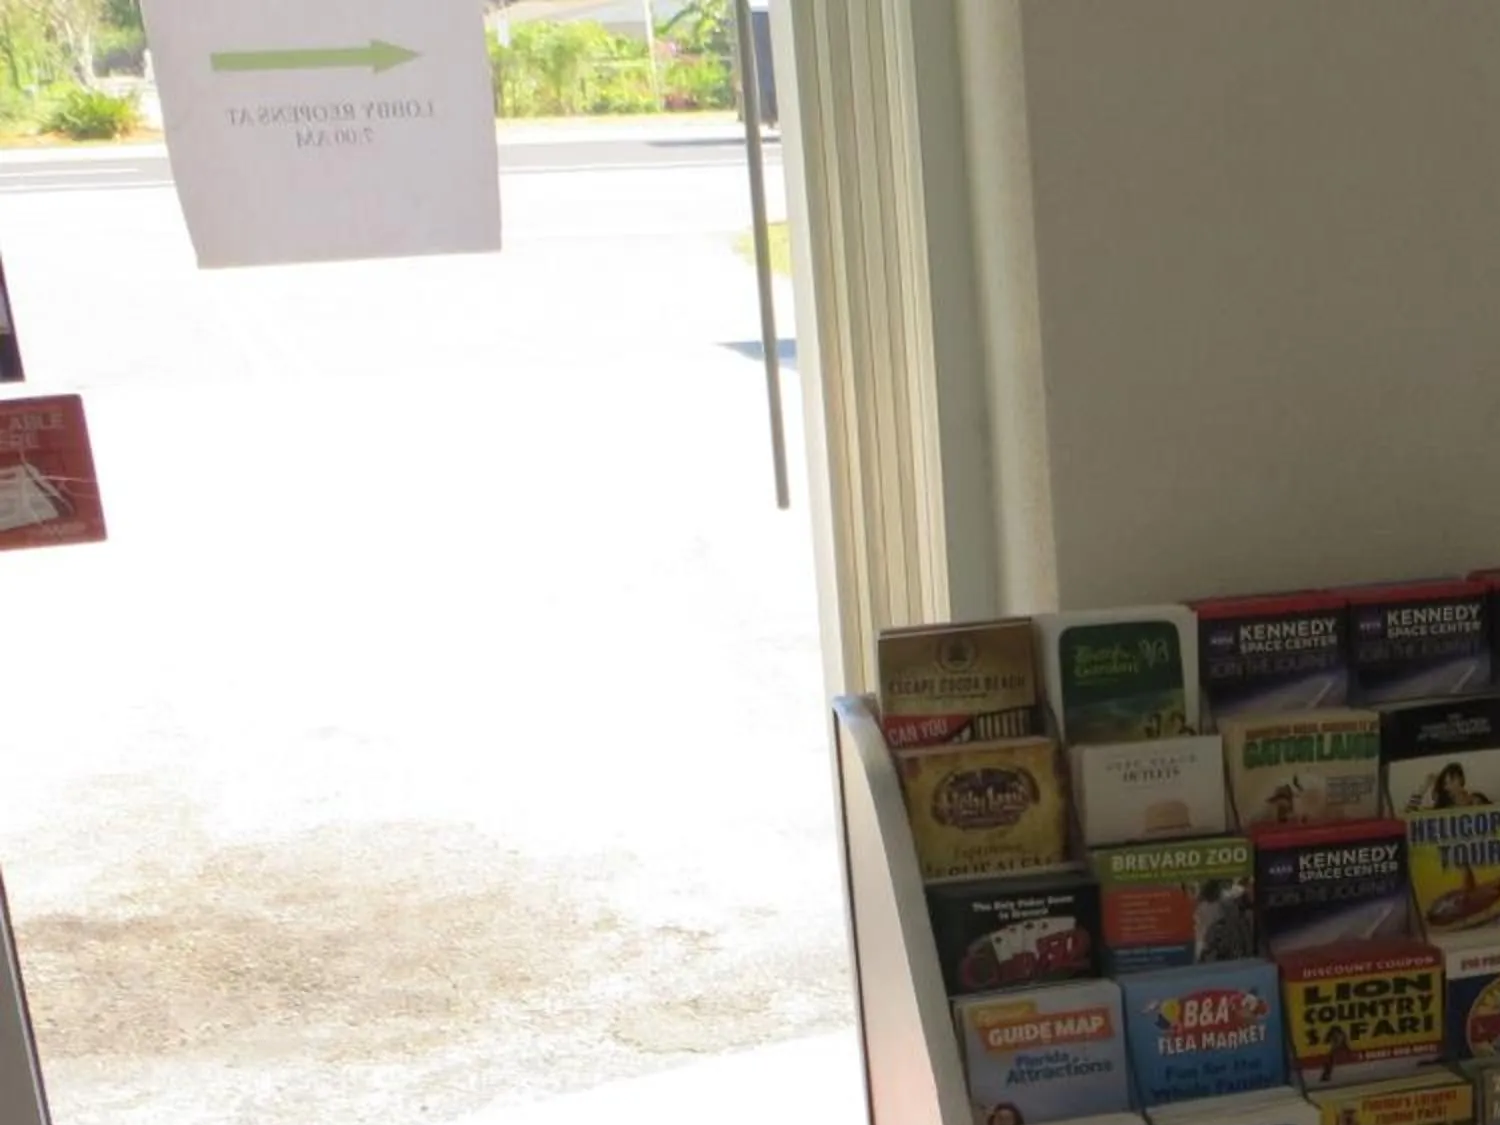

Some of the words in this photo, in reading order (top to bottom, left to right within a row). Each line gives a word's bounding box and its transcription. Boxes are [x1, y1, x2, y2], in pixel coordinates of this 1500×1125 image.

[1239, 617, 1337, 641] KENNEDY
[1388, 604, 1480, 627] KENNEDY
[1388, 625, 1428, 639] SPACE
[1430, 620, 1482, 636] CENTER
[1239, 639, 1283, 655] SPACE
[1285, 633, 1338, 651] CENTER
[888, 724, 919, 747] CAN
[921, 717, 949, 738] YOU
[1111, 850, 1201, 873] BREVARD
[1206, 846, 1248, 866] ZOO
[1299, 844, 1398, 870] KENNEDY
[1299, 867, 1341, 882] SPACE
[1344, 861, 1398, 877] CENTER
[1303, 962, 1374, 979] DISCOUNT
[1304, 973, 1433, 1005] LION
[1304, 993, 1434, 1025] COUNTRY
[988, 1021, 1053, 1047] GUIDE
[1055, 1015, 1105, 1037] MAP
[1157, 1033, 1197, 1056] FLEA
[1201, 1023, 1267, 1051] MARKET
[1304, 1013, 1434, 1047] SAFARI
[1006, 1056, 1114, 1087] Attractions
